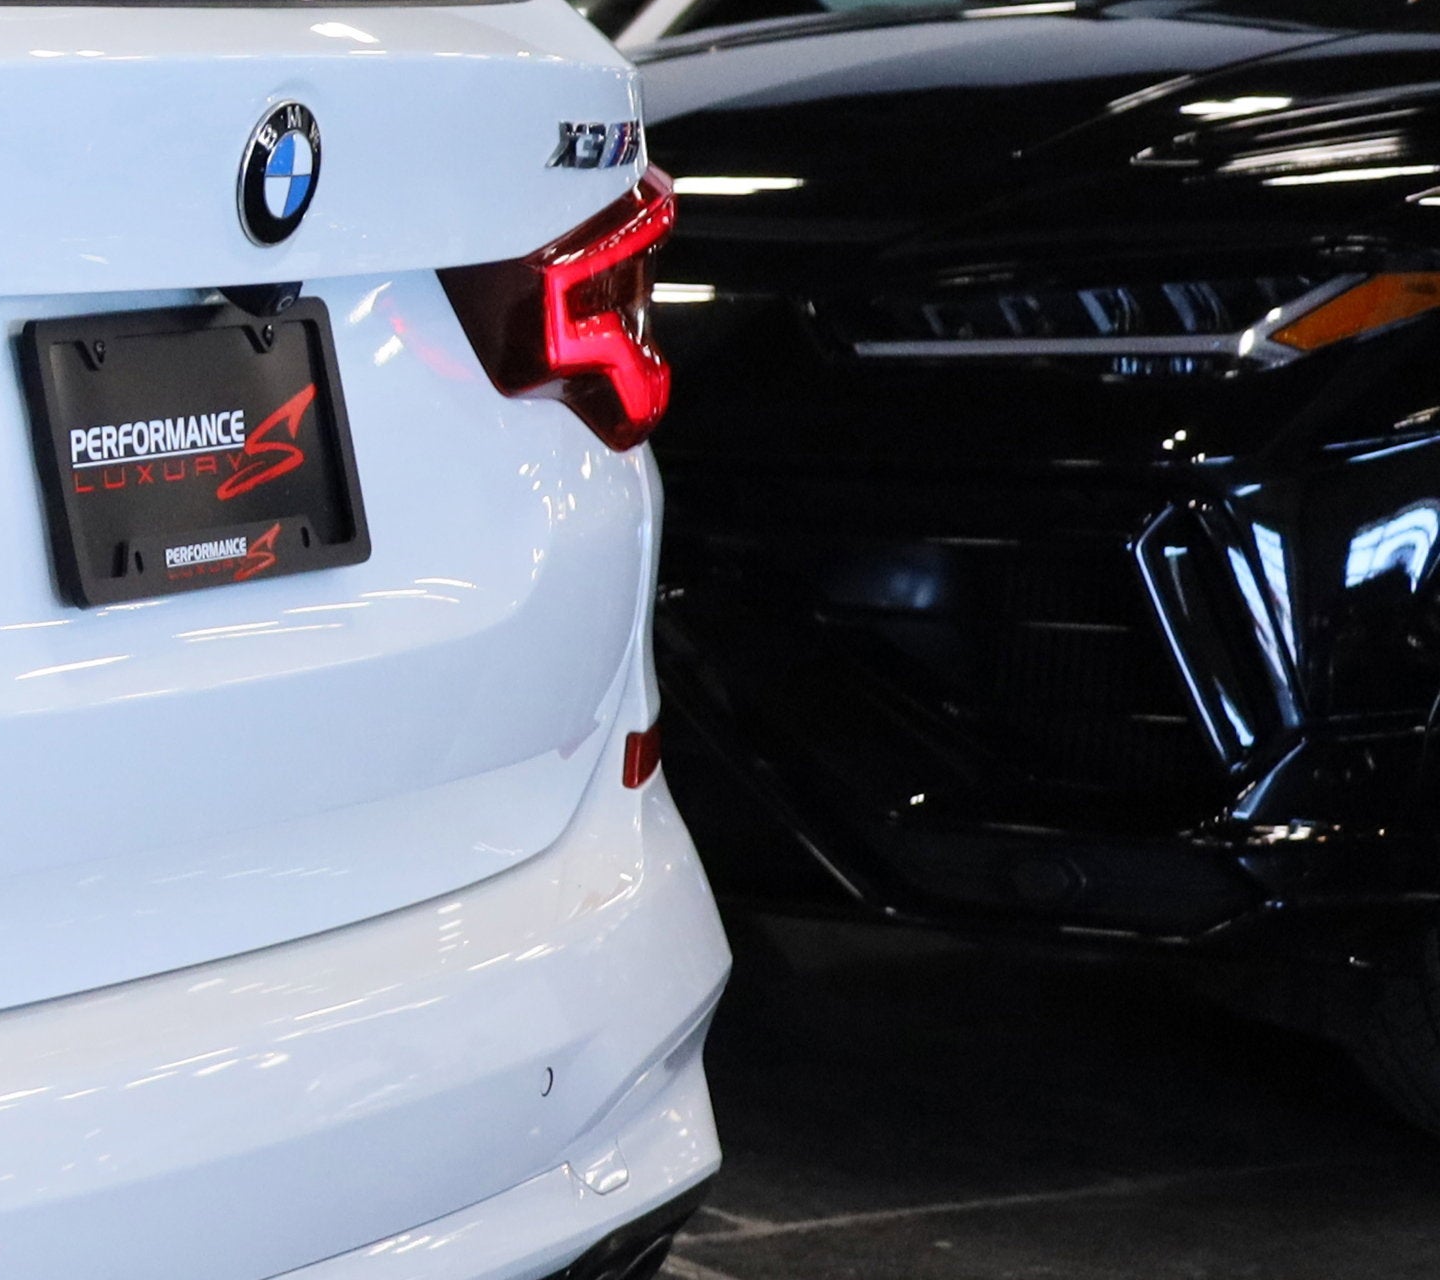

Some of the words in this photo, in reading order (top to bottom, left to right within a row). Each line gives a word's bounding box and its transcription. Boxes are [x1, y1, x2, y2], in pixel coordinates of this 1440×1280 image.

[258, 105, 320, 153] BMW
[70, 410, 245, 462] PERFORMANCE
[73, 452, 243, 493] LUXURY
[165, 536, 247, 565] PERFORMANCE
